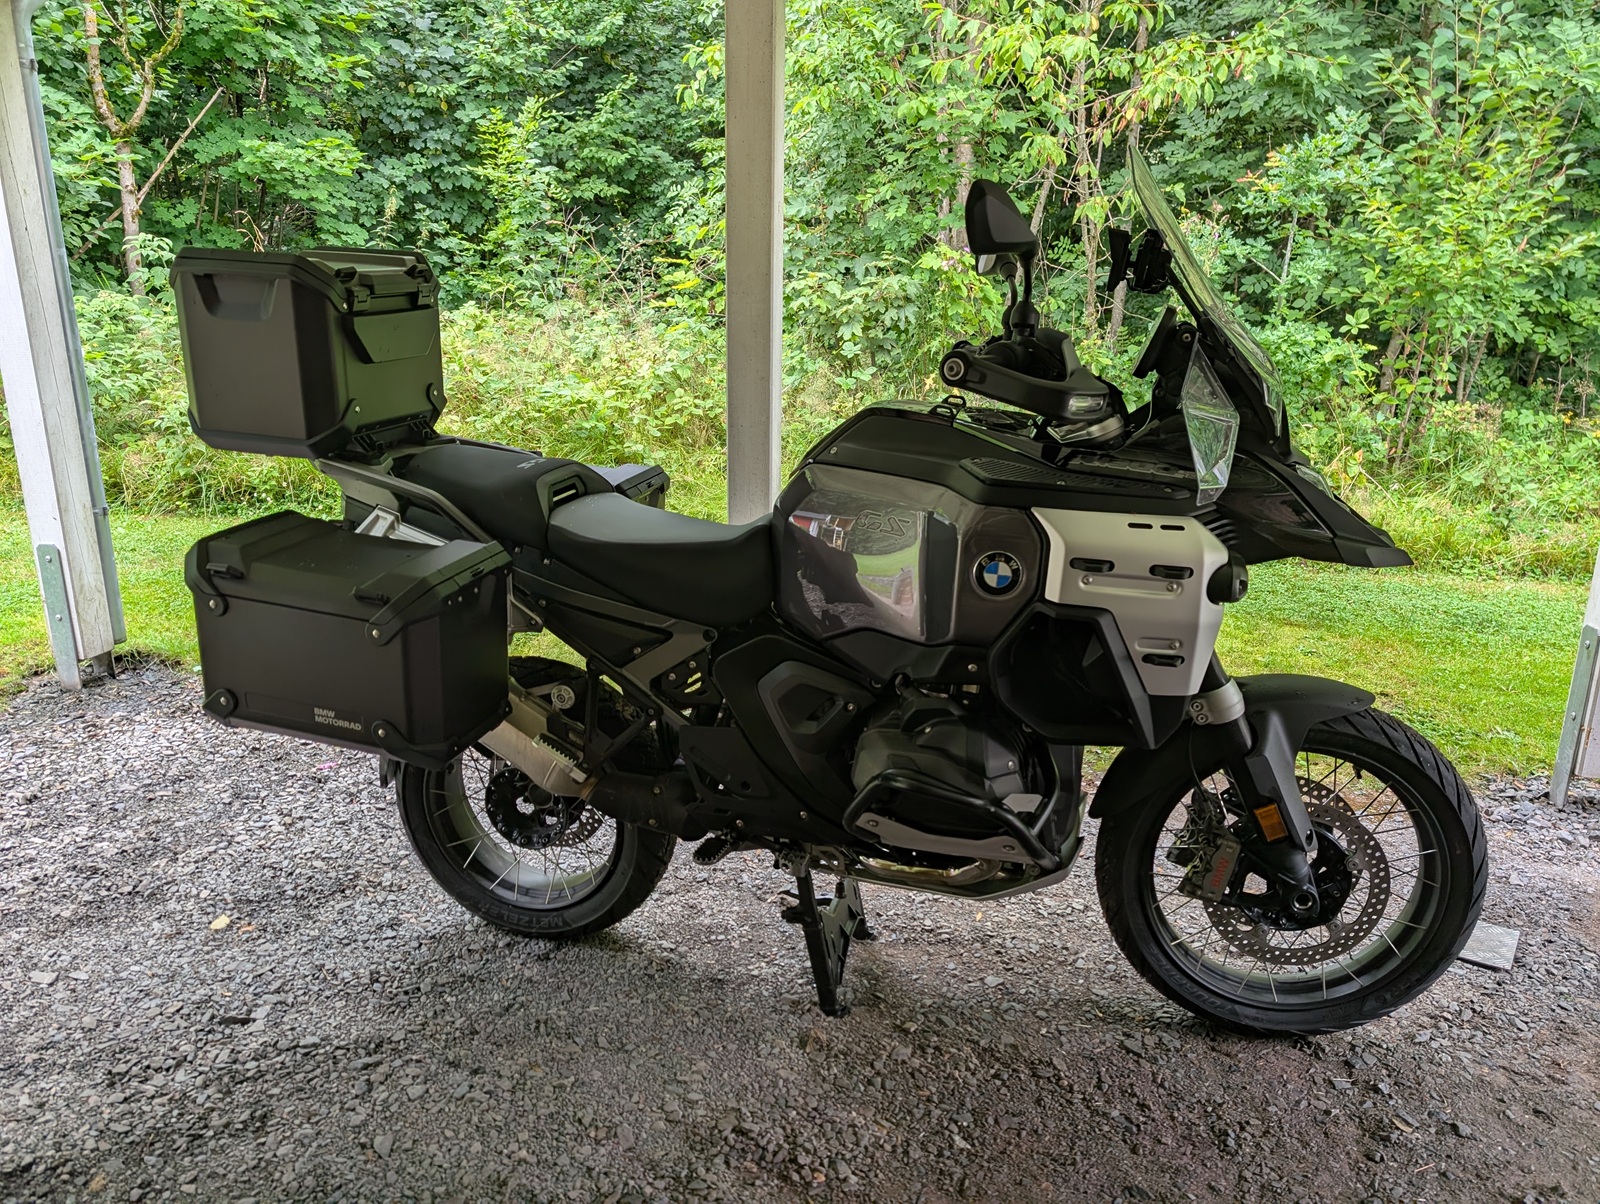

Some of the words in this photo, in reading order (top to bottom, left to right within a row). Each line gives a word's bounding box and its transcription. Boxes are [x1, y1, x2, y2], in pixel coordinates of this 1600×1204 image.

[980, 554, 1018, 569] BMW
[313, 707, 335, 718] BMW
[314, 715, 361, 731] MOTORRAD
[1211, 857, 1230, 887] BMW
[478, 901, 563, 928] METZELER
[1145, 944, 1232, 1014] TOURANCE
